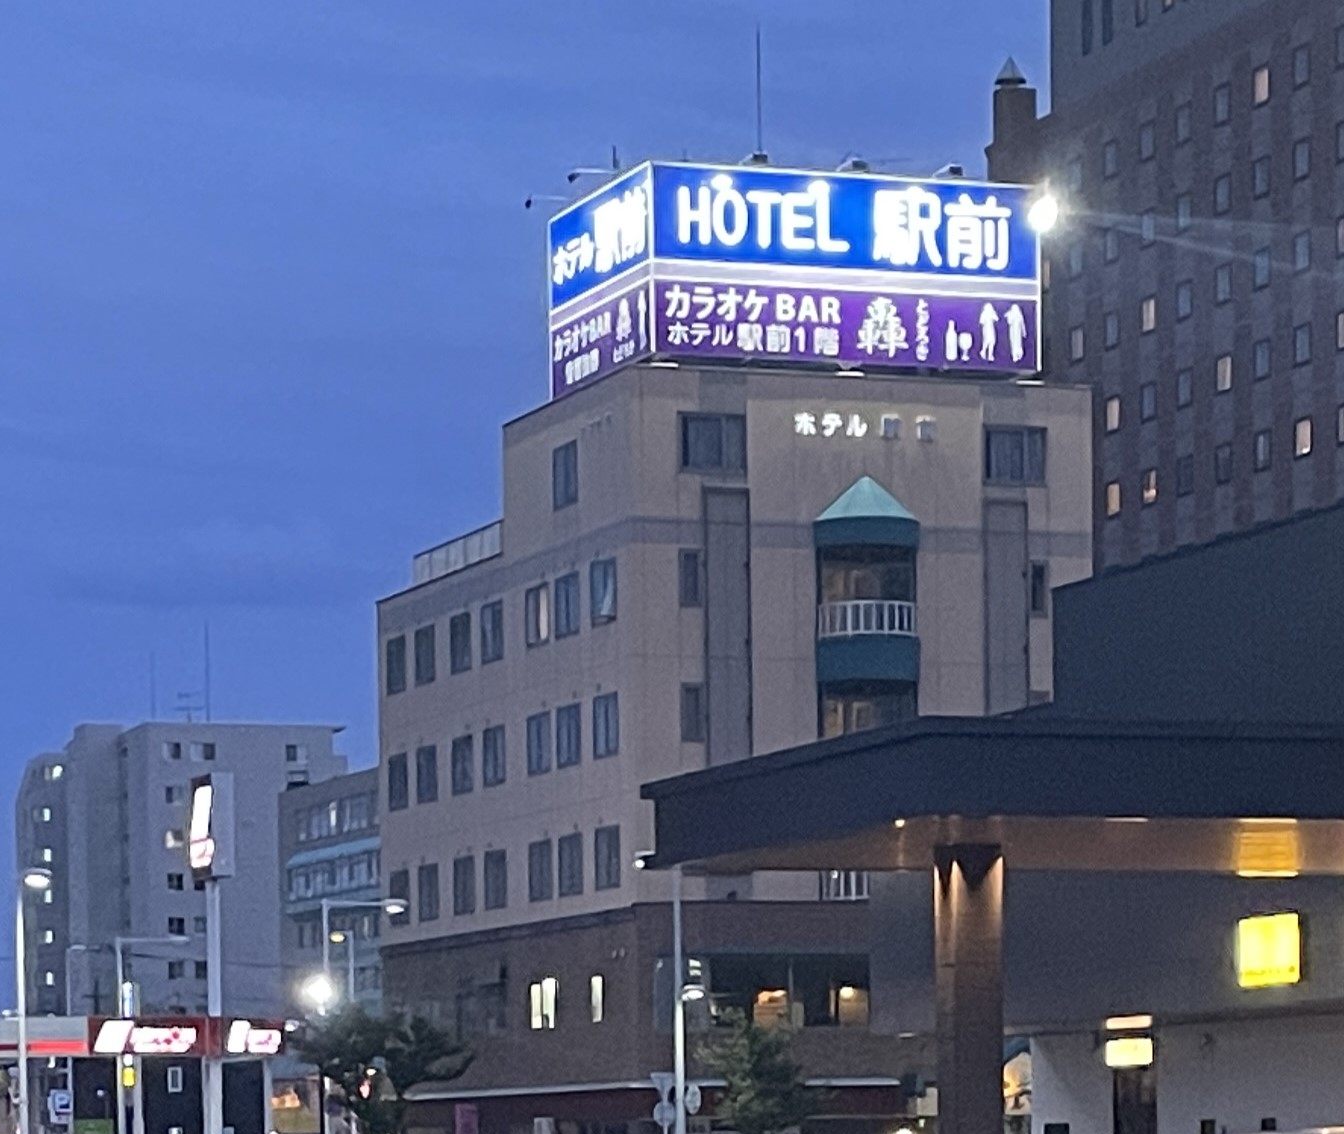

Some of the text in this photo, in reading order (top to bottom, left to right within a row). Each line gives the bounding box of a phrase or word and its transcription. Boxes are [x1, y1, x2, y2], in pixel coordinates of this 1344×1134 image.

[677, 183, 1012, 270] HOTEL 駅前
[665, 284, 769, 322] カラオケ
[776, 294, 841, 324] BAR
